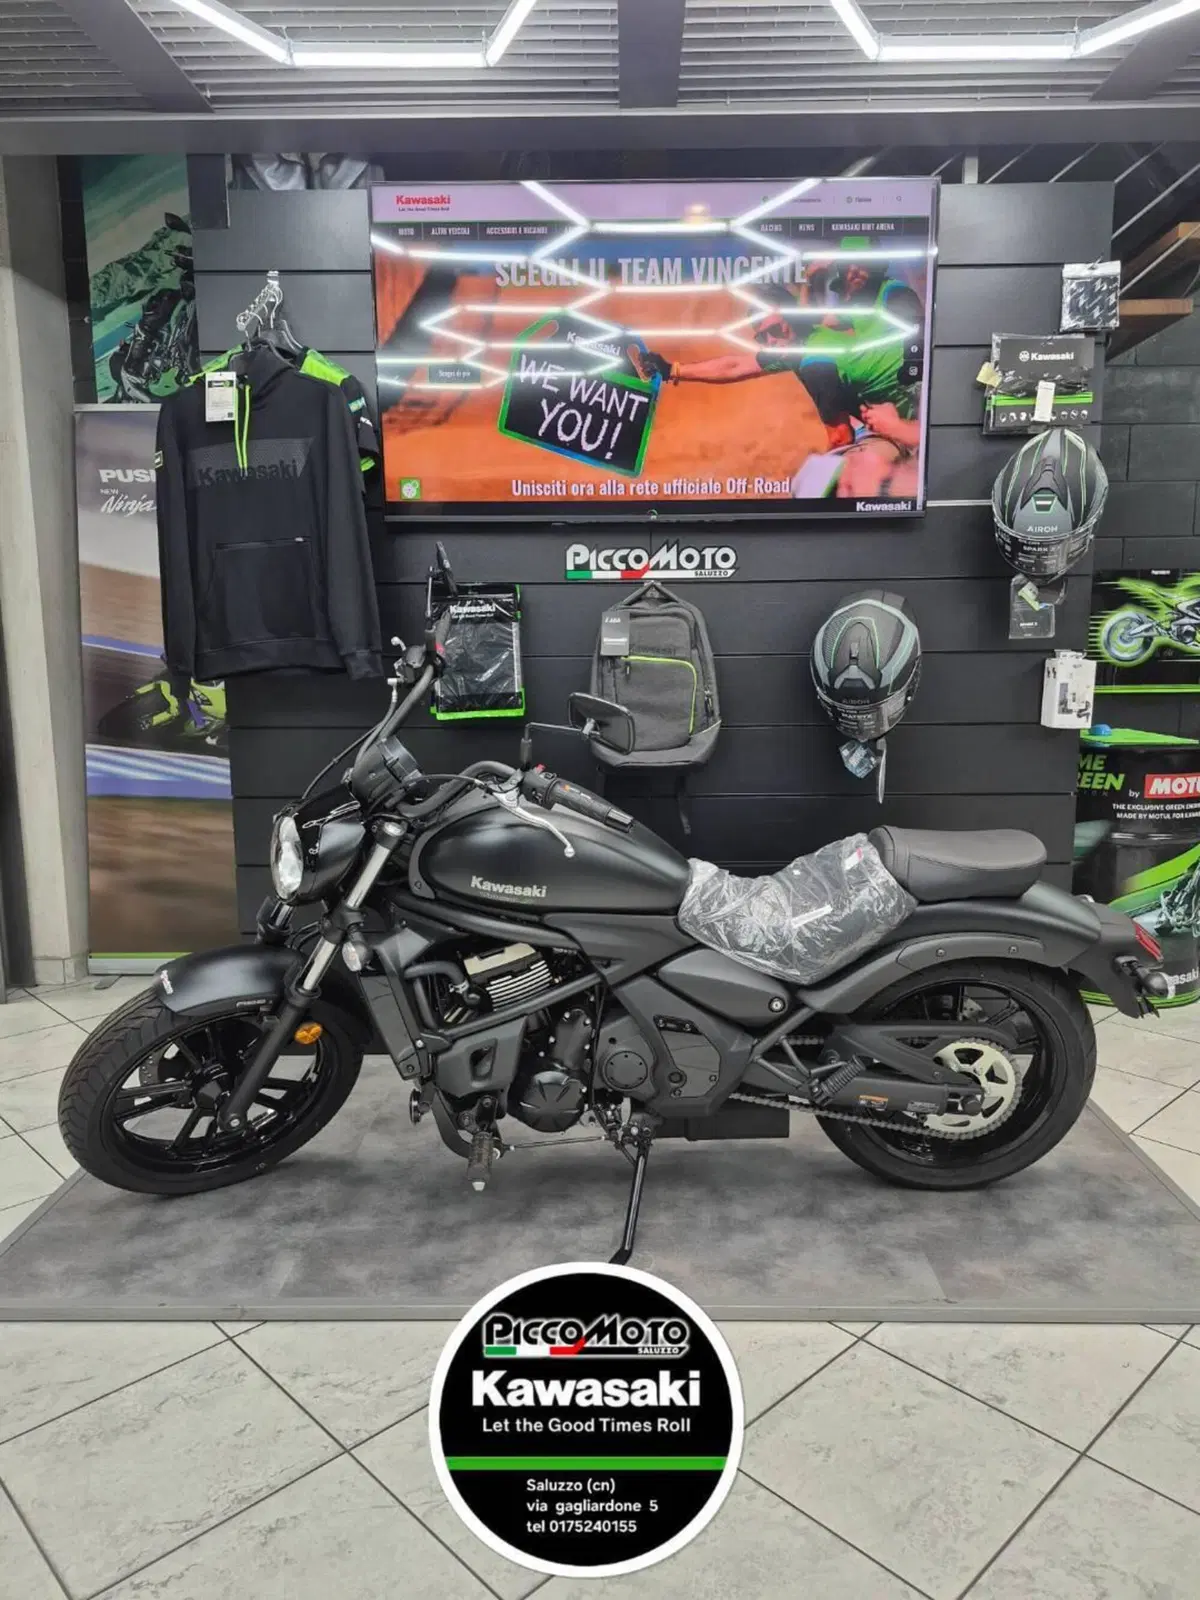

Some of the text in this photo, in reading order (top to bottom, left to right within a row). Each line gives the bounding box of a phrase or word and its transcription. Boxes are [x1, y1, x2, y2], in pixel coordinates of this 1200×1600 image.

[396, 194, 451, 206] Kawasaki
[798, 223, 815, 232] NEWS
[618, 256, 682, 286] TEAM
[691, 255, 808, 284] VINCENTE
[566, 331, 621, 356] Kaasaki
[1030, 351, 1075, 361] Kawasaki
[519, 354, 649, 422] WE WANT
[538, 398, 623, 460] YOU!
[511, 477, 791, 496] Unisciti ora alla rete ufficiale Off-Road
[100, 493, 158, 518] Ninja
[856, 501, 912, 512] Kawasaki
[1026, 525, 1059, 533] AIROH
[450, 603, 496, 614] Kawasaki
[1128, 789, 1140, 799] by
[1127, 803, 1165, 811] EXCLUSIVE
[1138, 812, 1148, 820] BY
[1148, 812, 1171, 820] MOTUL
[470, 874, 547, 898] Kawasaki
[1170, 966, 1199, 985] asaki
